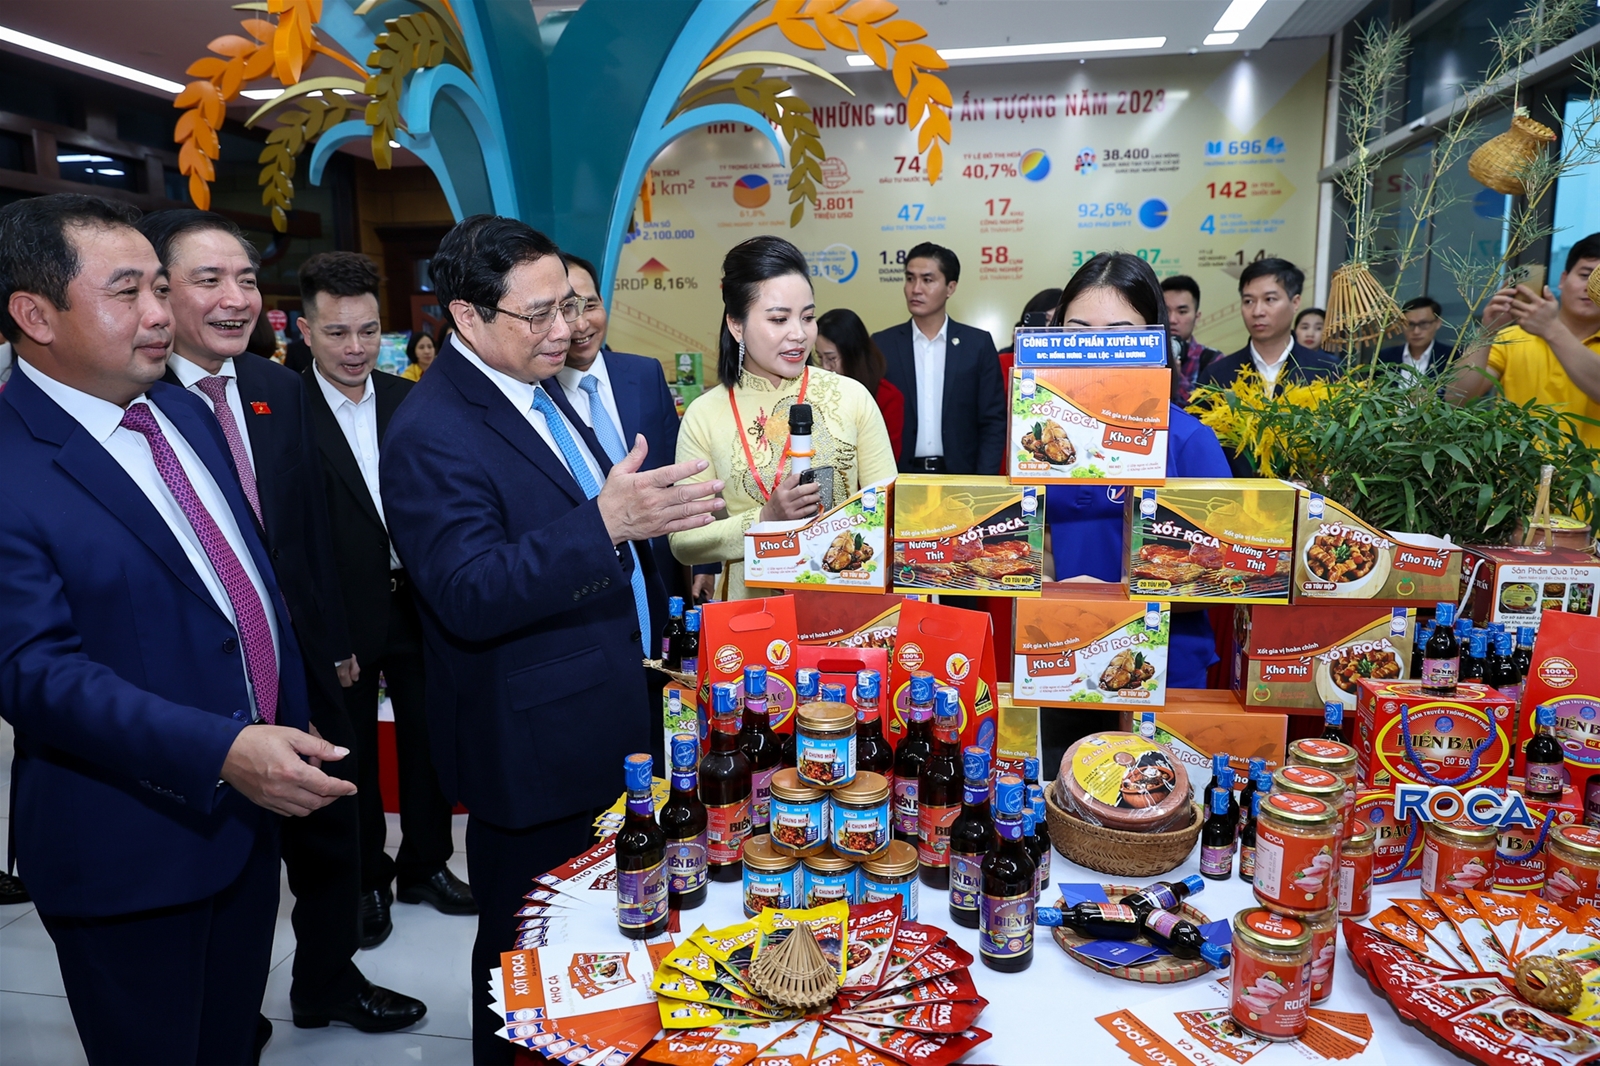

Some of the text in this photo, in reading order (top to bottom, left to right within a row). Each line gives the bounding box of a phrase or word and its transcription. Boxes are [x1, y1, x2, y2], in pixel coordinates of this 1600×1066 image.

[812, 88, 1166, 128] NHỮNG ẤN TƯỢNG NĂM 2023
[1103, 148, 1149, 161] 38.400
[1228, 140, 1262, 155] 696
[894, 156, 921, 173] 74
[962, 163, 1017, 180] 40,7%
[1206, 181, 1247, 199] 142
[897, 204, 925, 221] 47
[985, 198, 1011, 216] 17
[1078, 203, 1132, 218] 92,6%
[1200, 214, 1215, 235] 4
[643, 229, 695, 241] 2.100.000
[981, 246, 1009, 264] 58
[654, 277, 698, 291] 8,16%
[1023, 336, 1048, 348] CÔNG
[1050, 337, 1061, 347] TY
[1063, 334, 1076, 347] CỔ
[1106, 336, 1138, 346] XUYÊN
[1139, 334, 1160, 348] VIỆT
[1031, 400, 1099, 429] XỐT ROCA
[1112, 411, 1121, 420] gia
[1110, 431, 1148, 446] Kho Cá
[803, 513, 868, 541] XỐT ROCA
[911, 529, 921, 537] gia
[958, 517, 1025, 546] XỐT ROCA
[1152, 521, 1220, 549] XỐT ROCA
[1235, 532, 1244, 540] gia
[1320, 521, 1390, 549] XỐT ROCA
[760, 538, 795, 551] Kho Cá
[909, 541, 937, 552] Nướng
[1232, 544, 1263, 559] Nướng
[926, 551, 945, 562] Thịt
[1400, 552, 1443, 570] Kho Thịt
[1246, 559, 1266, 573] Thịt
[1511, 566, 1526, 575] Sản
[1528, 566, 1548, 576] Phẩm
[1550, 567, 1568, 577] Quà
[1570, 568, 1589, 578] Tặng
[800, 632, 809, 640] gia
[1033, 641, 1043, 650] gia
[1080, 632, 1150, 660] XỐT ROCA
[1268, 648, 1278, 657] gia
[1319, 637, 1393, 665] XỐT ROCA
[719, 653, 738, 664] 100%
[1033, 656, 1070, 669] Kho Cá
[1266, 664, 1308, 677] Kho Thịt
[1465, 713, 1478, 724] PHAN
[1395, 784, 1536, 829] ROCA
[1265, 832, 1285, 845] ROCA
[570, 869, 592, 883] KHO
[860, 909, 893, 925] ROCA
[859, 925, 890, 938] Kho Thịt
[1255, 922, 1292, 935] ROCA
[718, 936, 738, 953] XỐT
[511, 952, 527, 979] ROCA
[545, 974, 562, 1003] KHO CÁ
[938, 1003, 952, 1026] ROCA
[1111, 1017, 1151, 1047] ROCA
[668, 1041, 707, 1053] ROCA
[1452, 1025, 1501, 1056] ROCA
